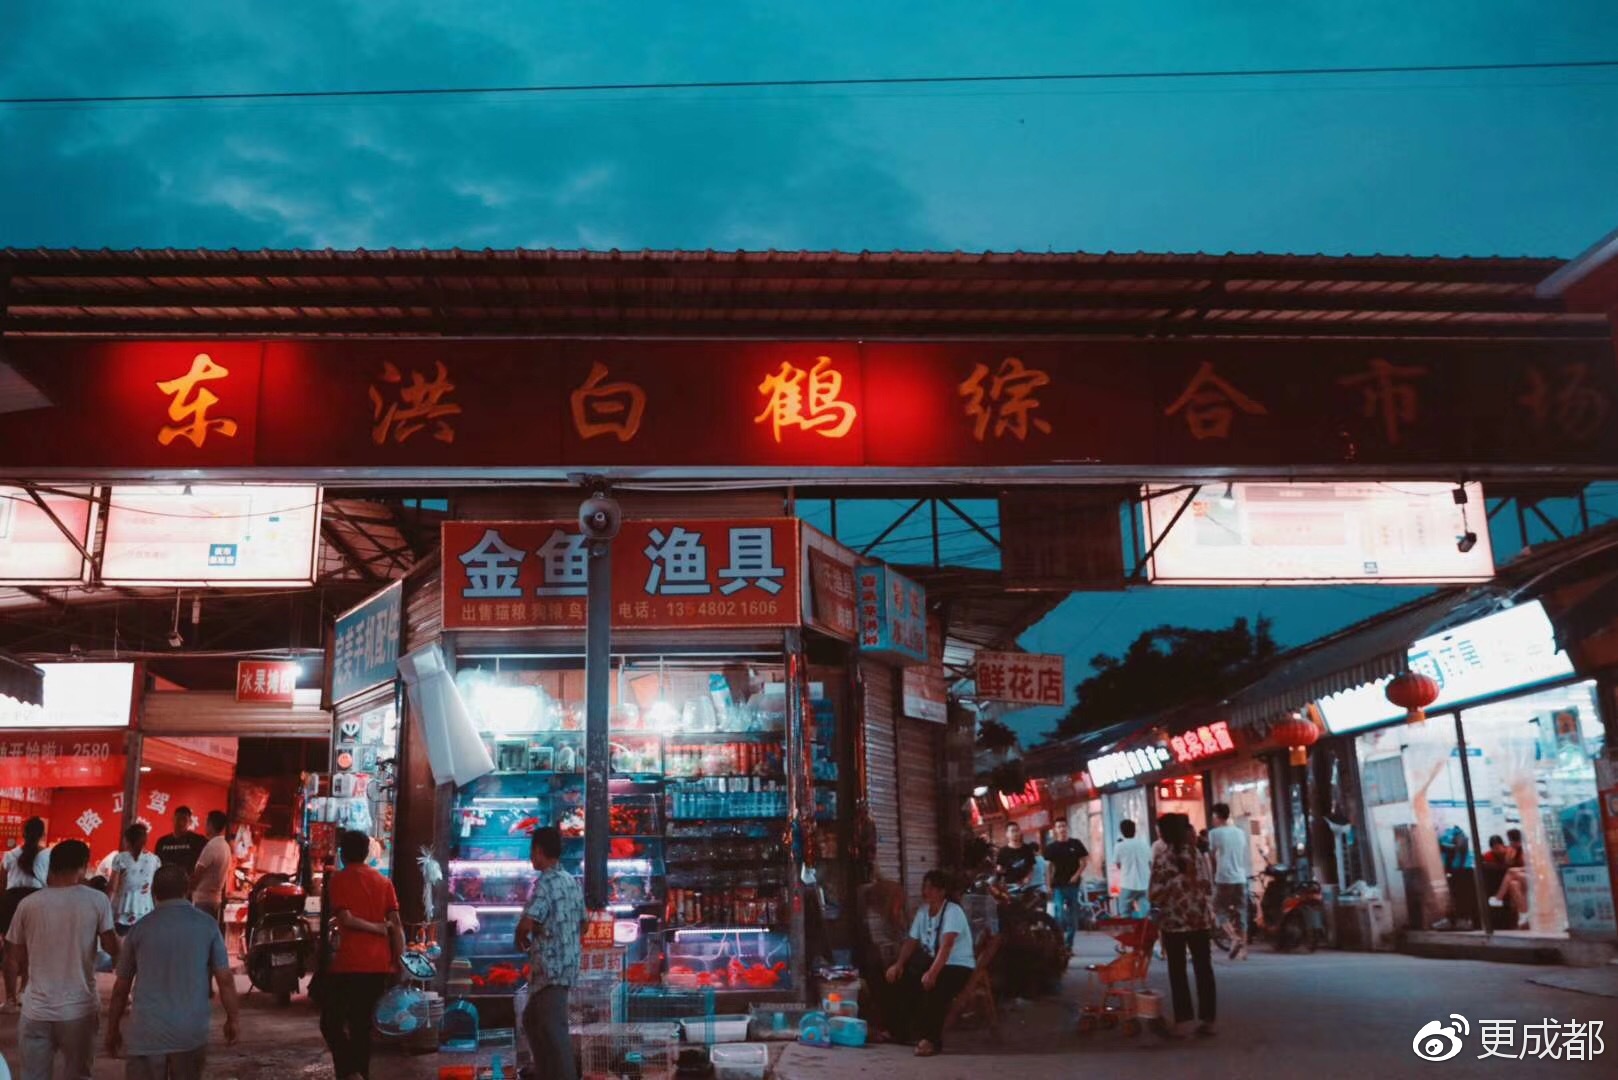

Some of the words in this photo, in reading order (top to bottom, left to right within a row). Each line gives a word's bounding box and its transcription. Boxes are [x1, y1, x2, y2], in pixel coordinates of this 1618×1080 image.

[458, 530, 588, 597] 金鱼
[644, 527, 785, 595] 渔具
[979, 663, 1062, 702] 鲜花店
[73, 742, 110, 761] 2580
